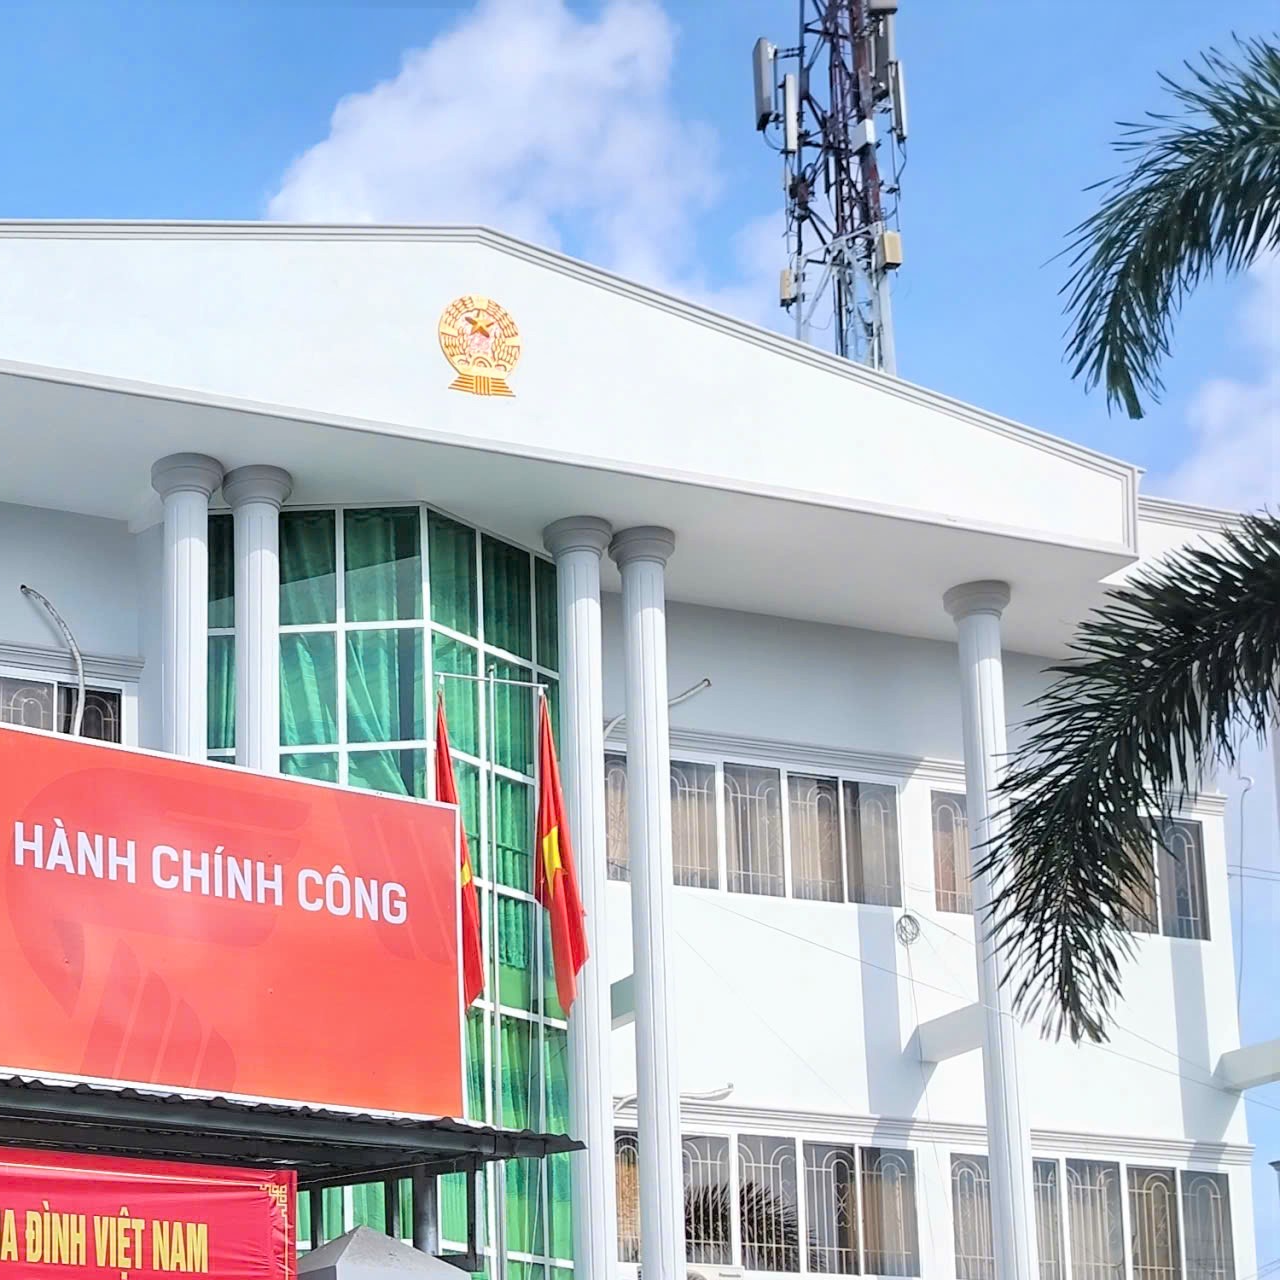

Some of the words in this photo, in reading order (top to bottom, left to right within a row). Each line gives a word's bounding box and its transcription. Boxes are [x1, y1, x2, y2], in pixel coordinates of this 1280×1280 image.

[14, 818, 136, 883] HÀNH
[151, 845, 284, 906] CHÍNH
[297, 865, 408, 925] CÔNG
[25, 1201, 86, 1266] ĐÌNH
[93, 1206, 146, 1280] VIỆT
[153, 1222, 208, 1273] NAM
